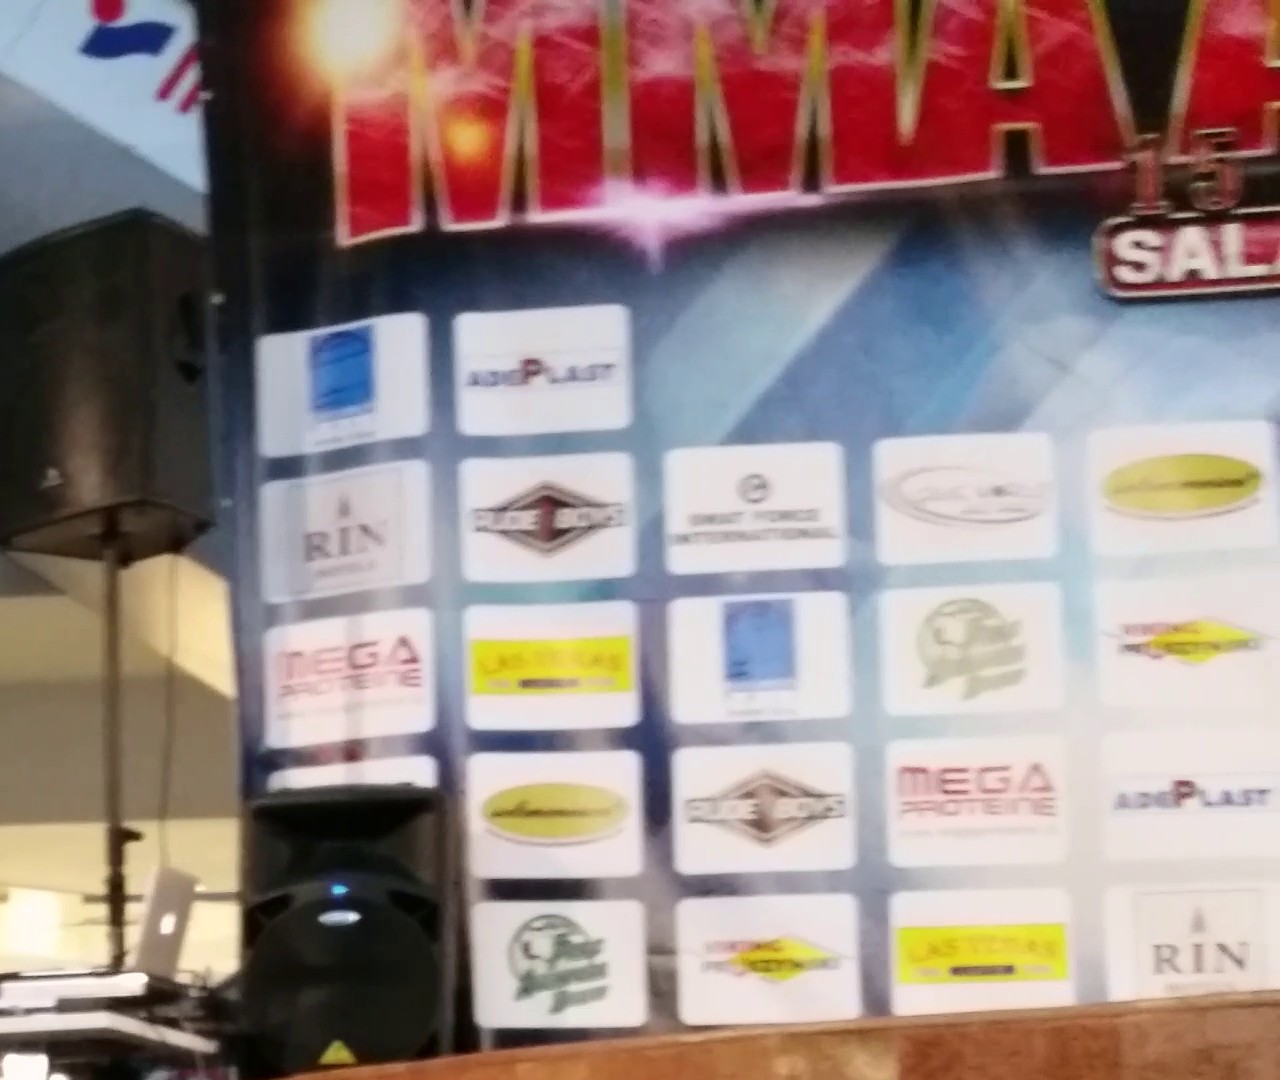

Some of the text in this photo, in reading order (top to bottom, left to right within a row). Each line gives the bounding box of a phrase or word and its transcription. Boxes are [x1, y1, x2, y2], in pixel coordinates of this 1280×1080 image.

[1110, 222, 1280, 286] SAL
[303, 522, 390, 564] RIN
[899, 762, 1057, 797] MEGA
[1151, 941, 1251, 975] RIN
